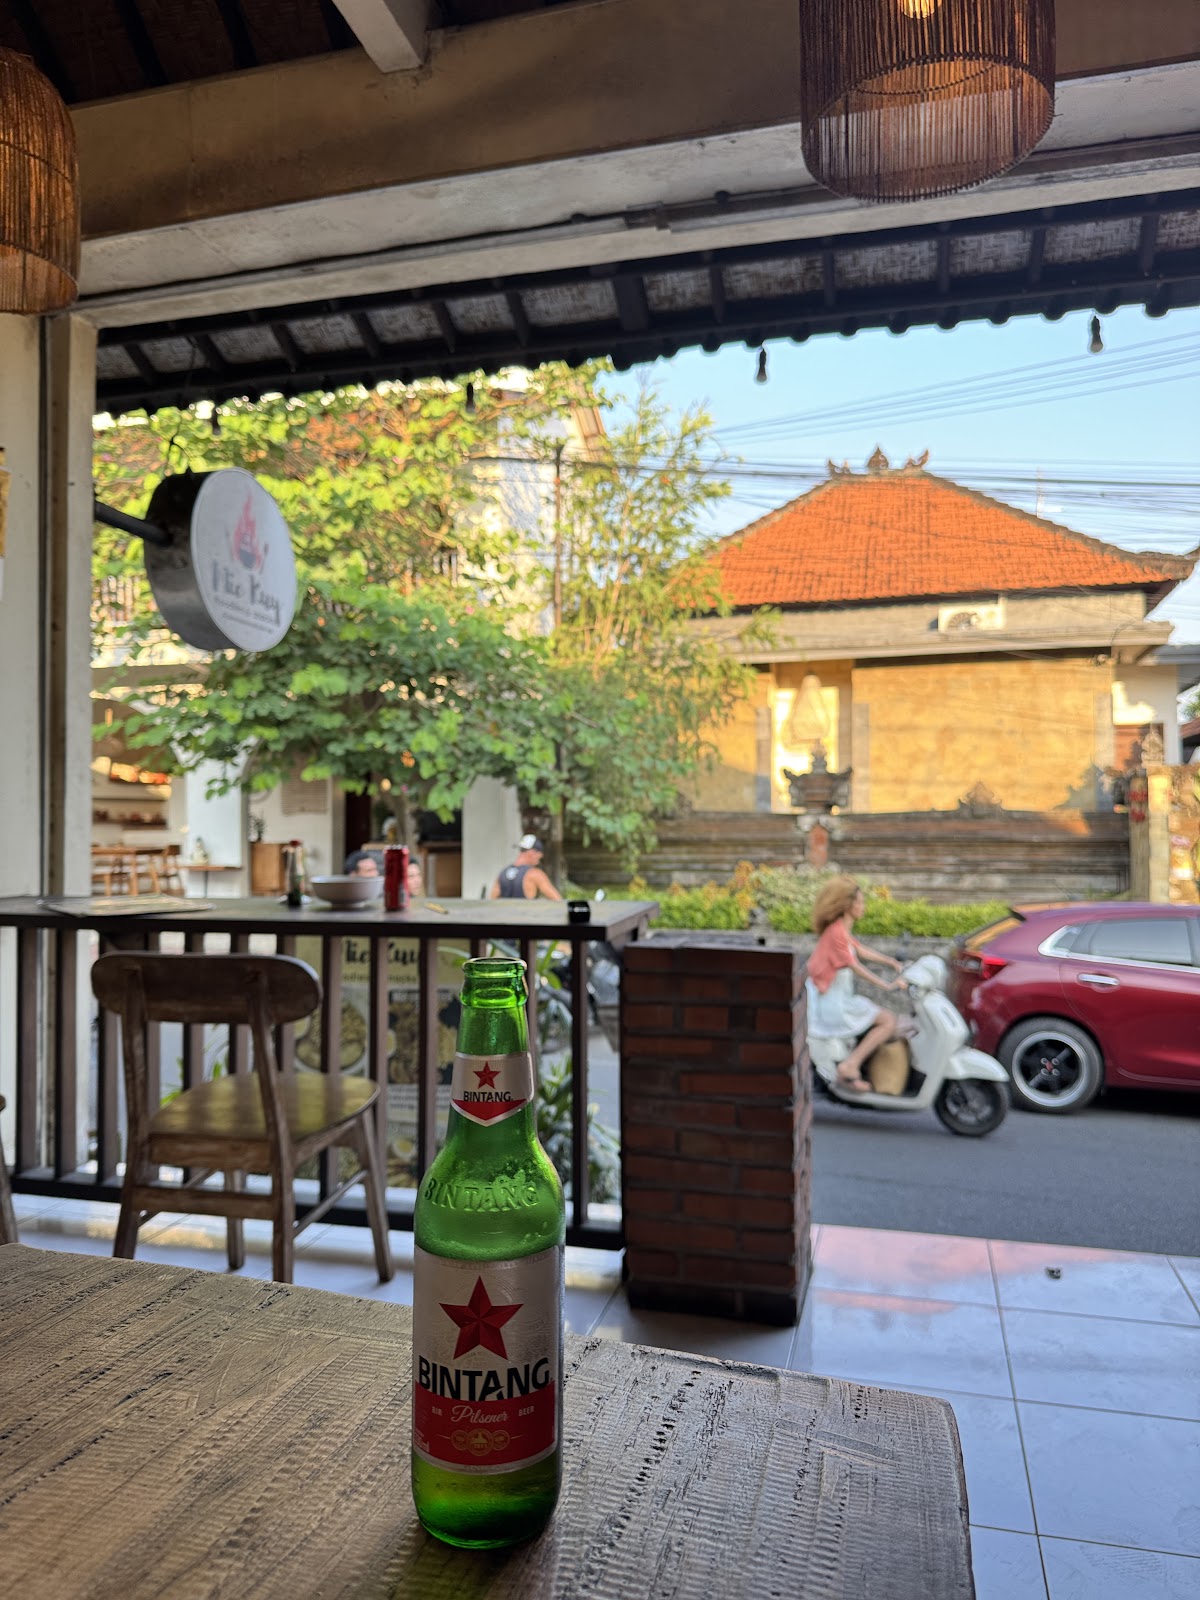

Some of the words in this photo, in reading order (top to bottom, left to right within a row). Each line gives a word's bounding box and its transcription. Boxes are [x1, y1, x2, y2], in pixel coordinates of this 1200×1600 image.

[463, 1091, 512, 1102] BINTANG
[424, 1178, 538, 1212] BINTANG
[418, 1355, 550, 1402] BINTANG
[451, 1405, 509, 1424] Pilsener
[518, 1406, 535, 1417] BEER
